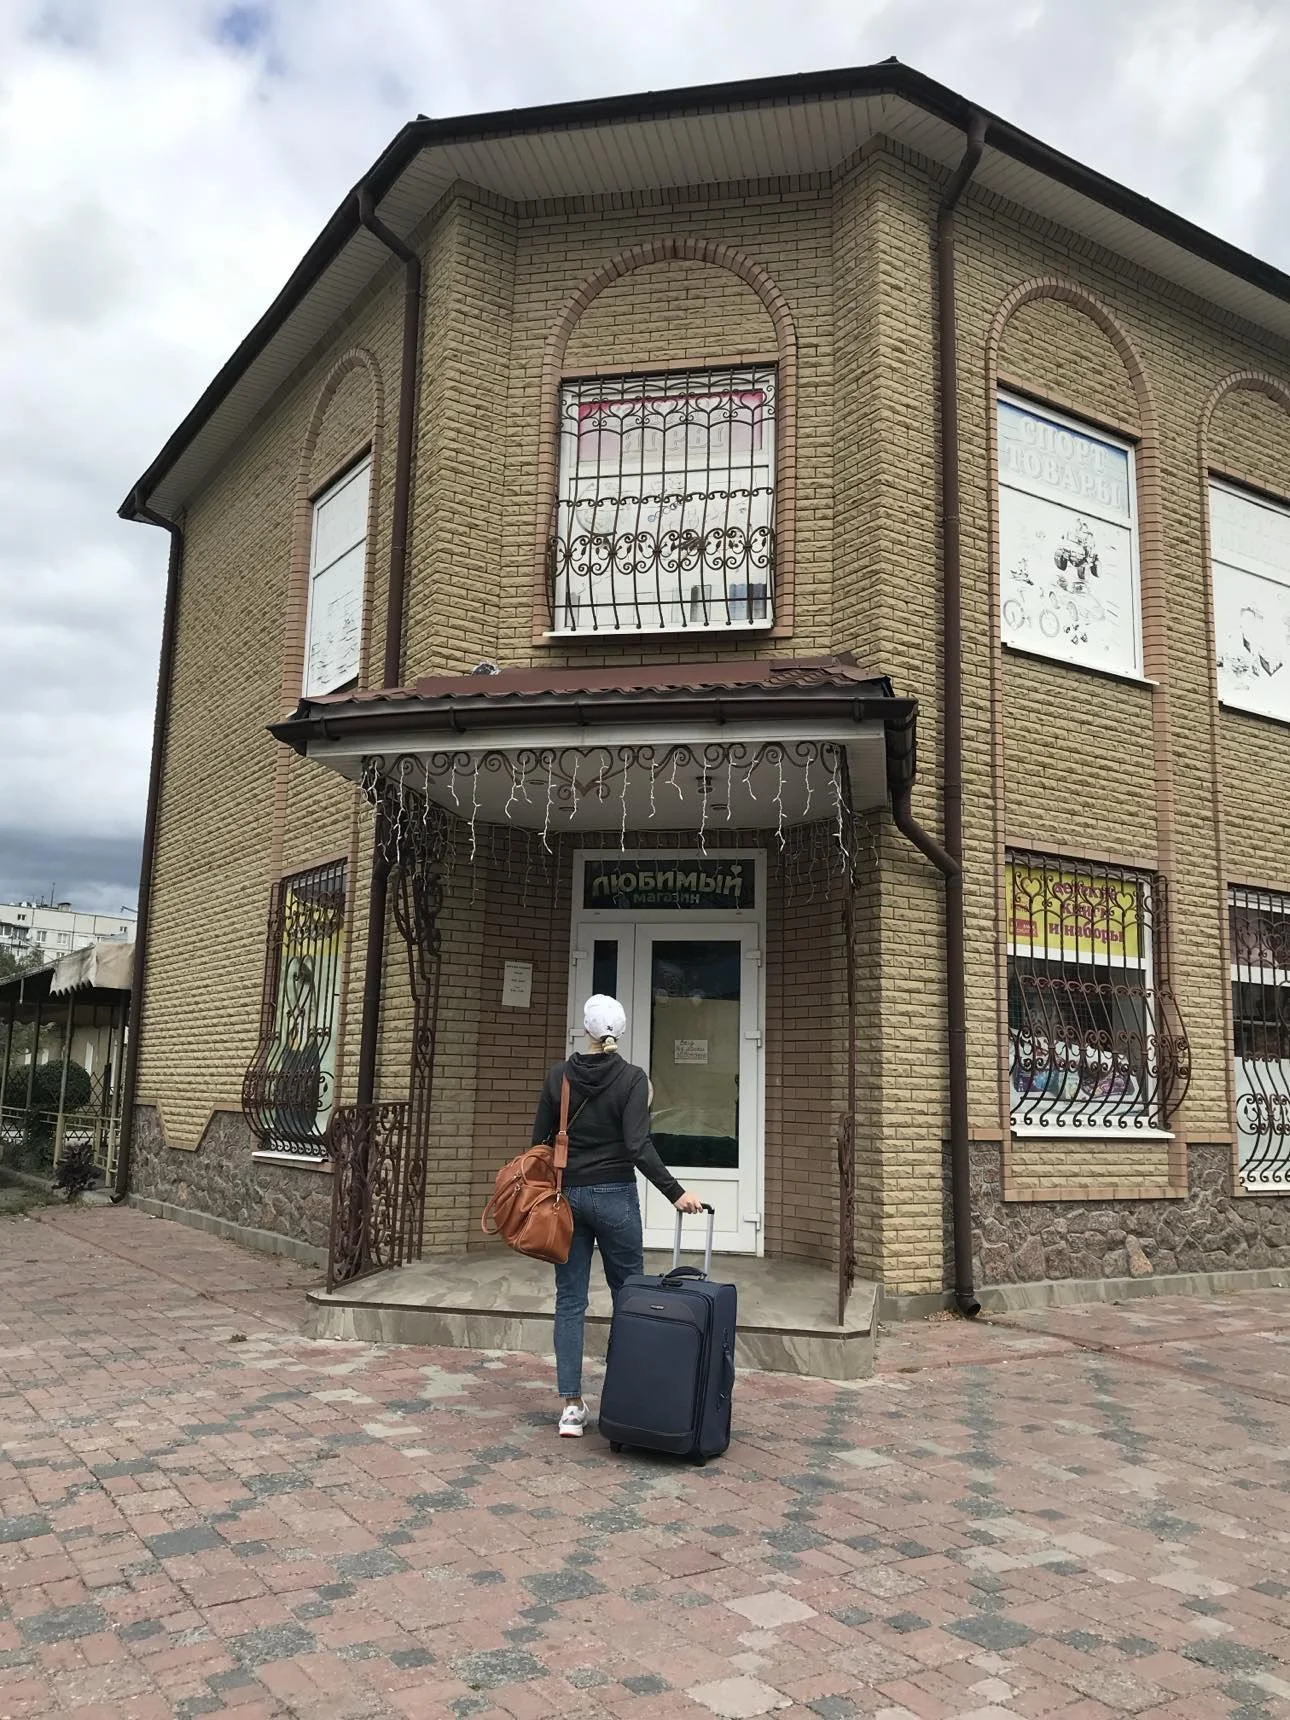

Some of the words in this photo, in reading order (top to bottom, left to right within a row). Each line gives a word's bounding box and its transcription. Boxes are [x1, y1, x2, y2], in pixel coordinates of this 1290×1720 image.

[1020, 416, 1107, 474] СПОРТ
[1007, 443, 1122, 509] ТОВАРЫ
[633, 892, 700, 905] магазин
[1064, 920, 1125, 944] наборы
